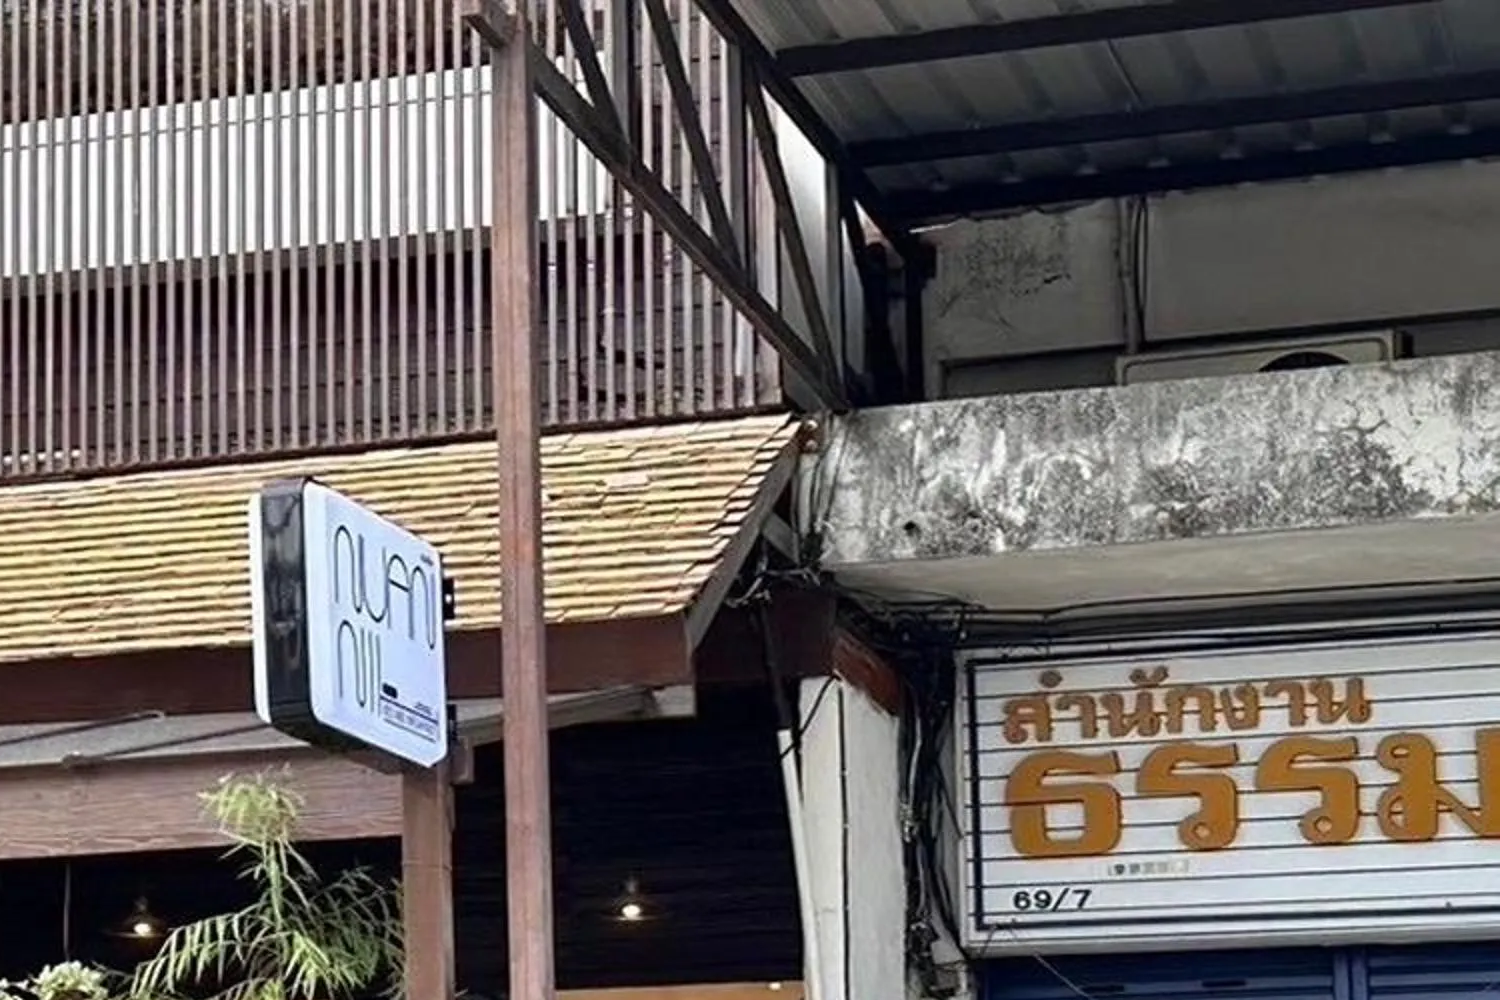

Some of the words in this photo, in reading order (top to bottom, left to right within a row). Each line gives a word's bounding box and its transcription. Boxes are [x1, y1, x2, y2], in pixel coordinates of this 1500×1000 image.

[333, 525, 437, 650] NUAN
[1002, 665, 1372, 743] สำนักงาน
[1013, 888, 1092, 911] 69/7
